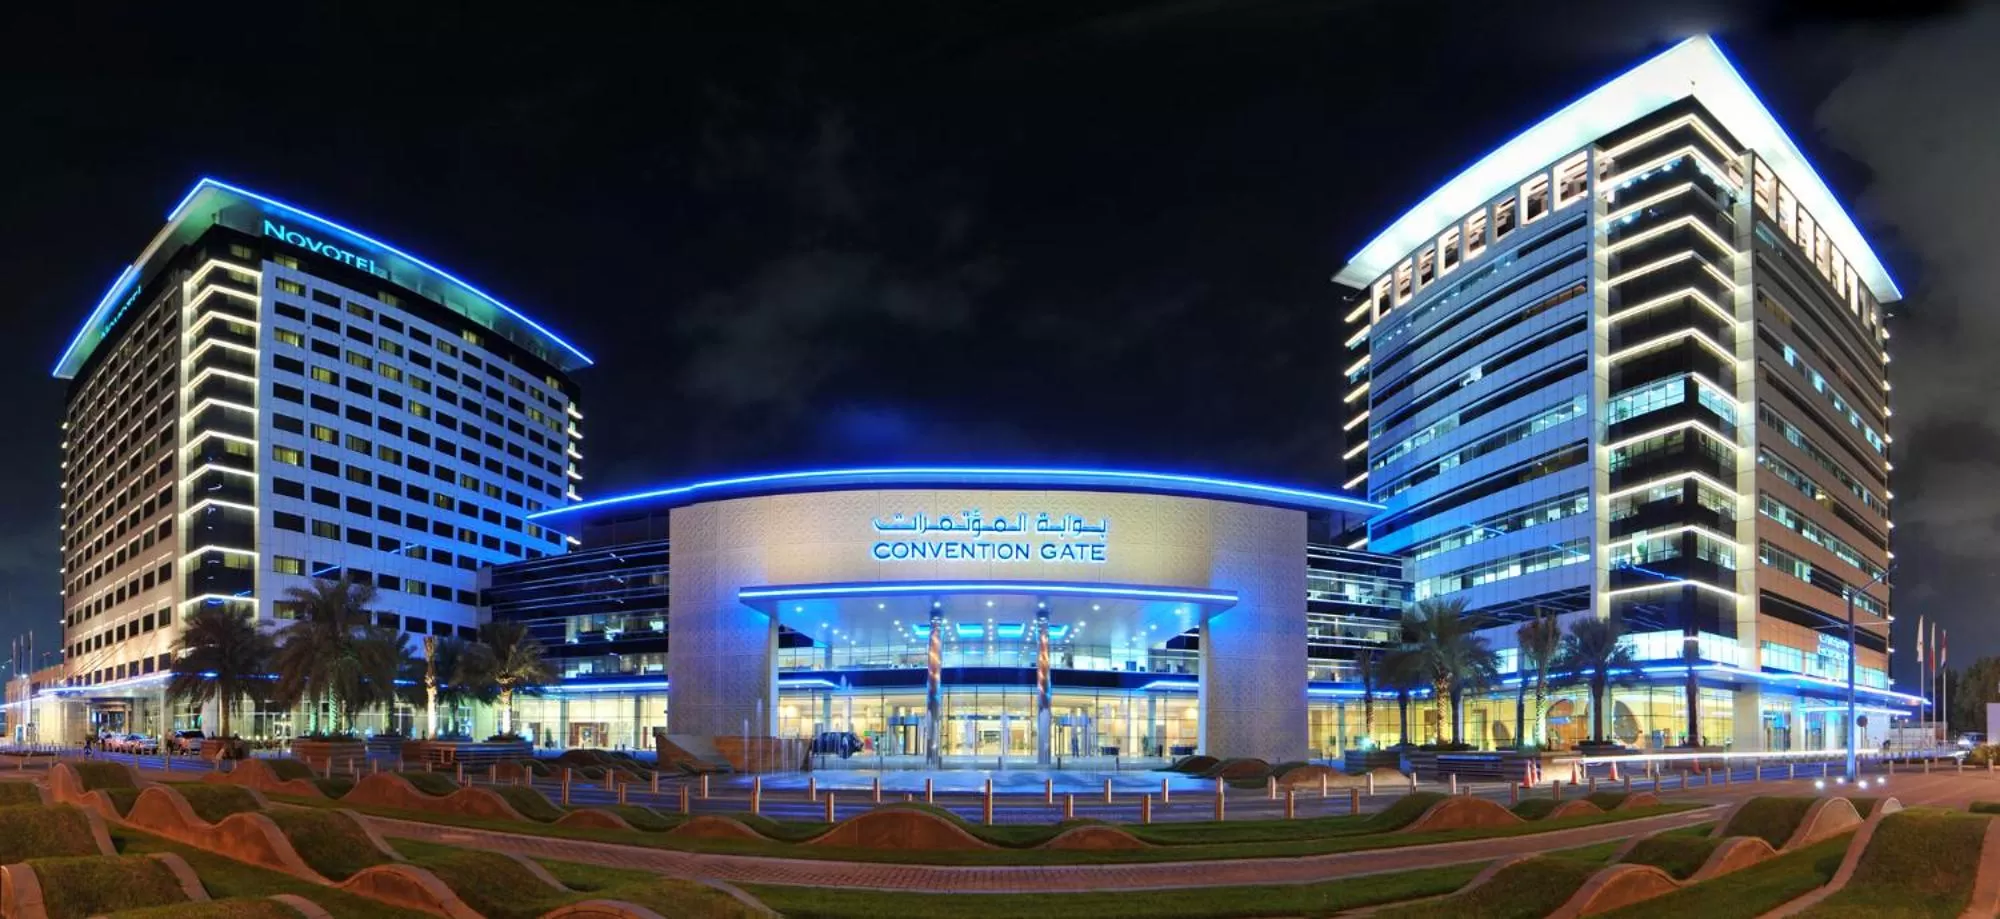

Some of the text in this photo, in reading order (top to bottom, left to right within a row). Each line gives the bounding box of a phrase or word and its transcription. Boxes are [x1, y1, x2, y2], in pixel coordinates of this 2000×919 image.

[263, 219, 376, 274] NOVOTEL
[873, 509, 1108, 539] بوابة المؤتمرات
[873, 542, 1107, 561] CONVENTION GATE
